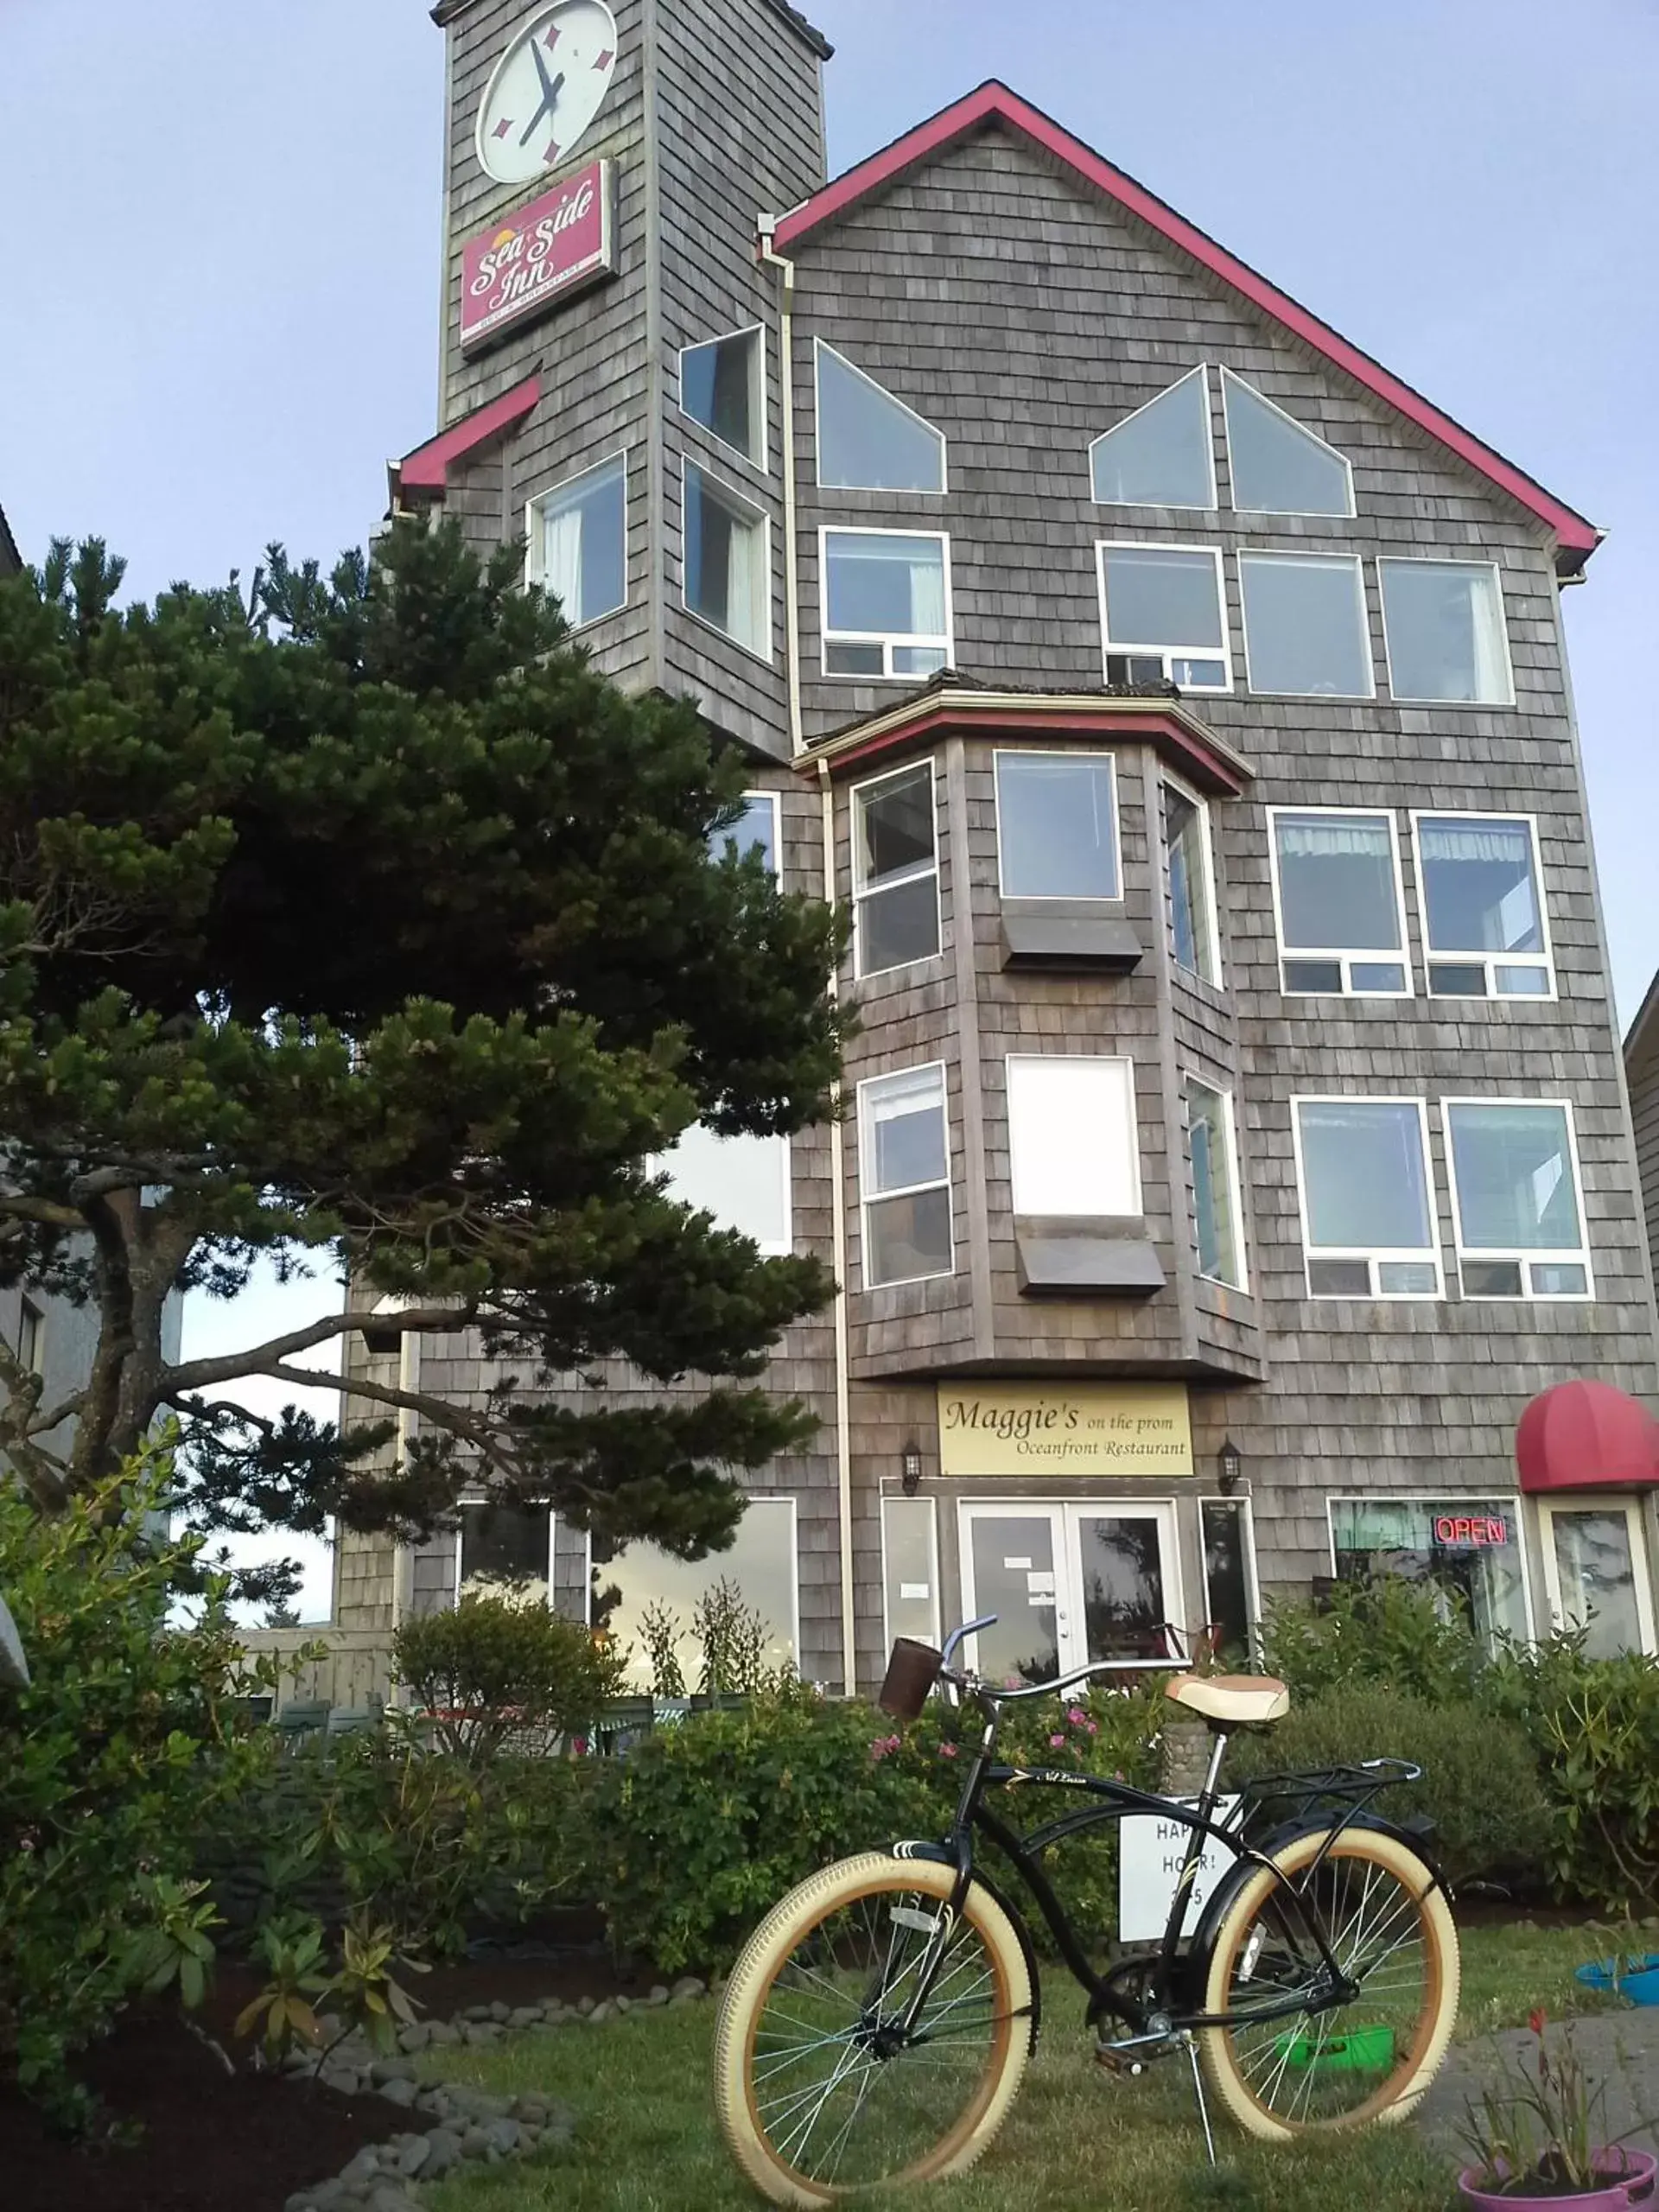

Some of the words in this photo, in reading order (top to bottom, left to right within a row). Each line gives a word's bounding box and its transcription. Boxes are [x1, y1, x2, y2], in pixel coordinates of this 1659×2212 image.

[470, 232, 525, 296] Sea
[527, 179, 594, 263] Side
[489, 259, 554, 310] Inn
[945, 1400, 1080, 1440] Maggie's
[1087, 1419, 1106, 1430] on
[1109, 1413, 1134, 1431] the
[1135, 1418, 1174, 1434] prom
[1016, 1439, 1099, 1459] Oceanfront
[1104, 1440, 1185, 1457] Restaurant
[1438, 1518, 1503, 1541] OPEN
[1157, 1822, 1190, 1840] HAP
[1163, 1854, 1216, 1873] HOR!
